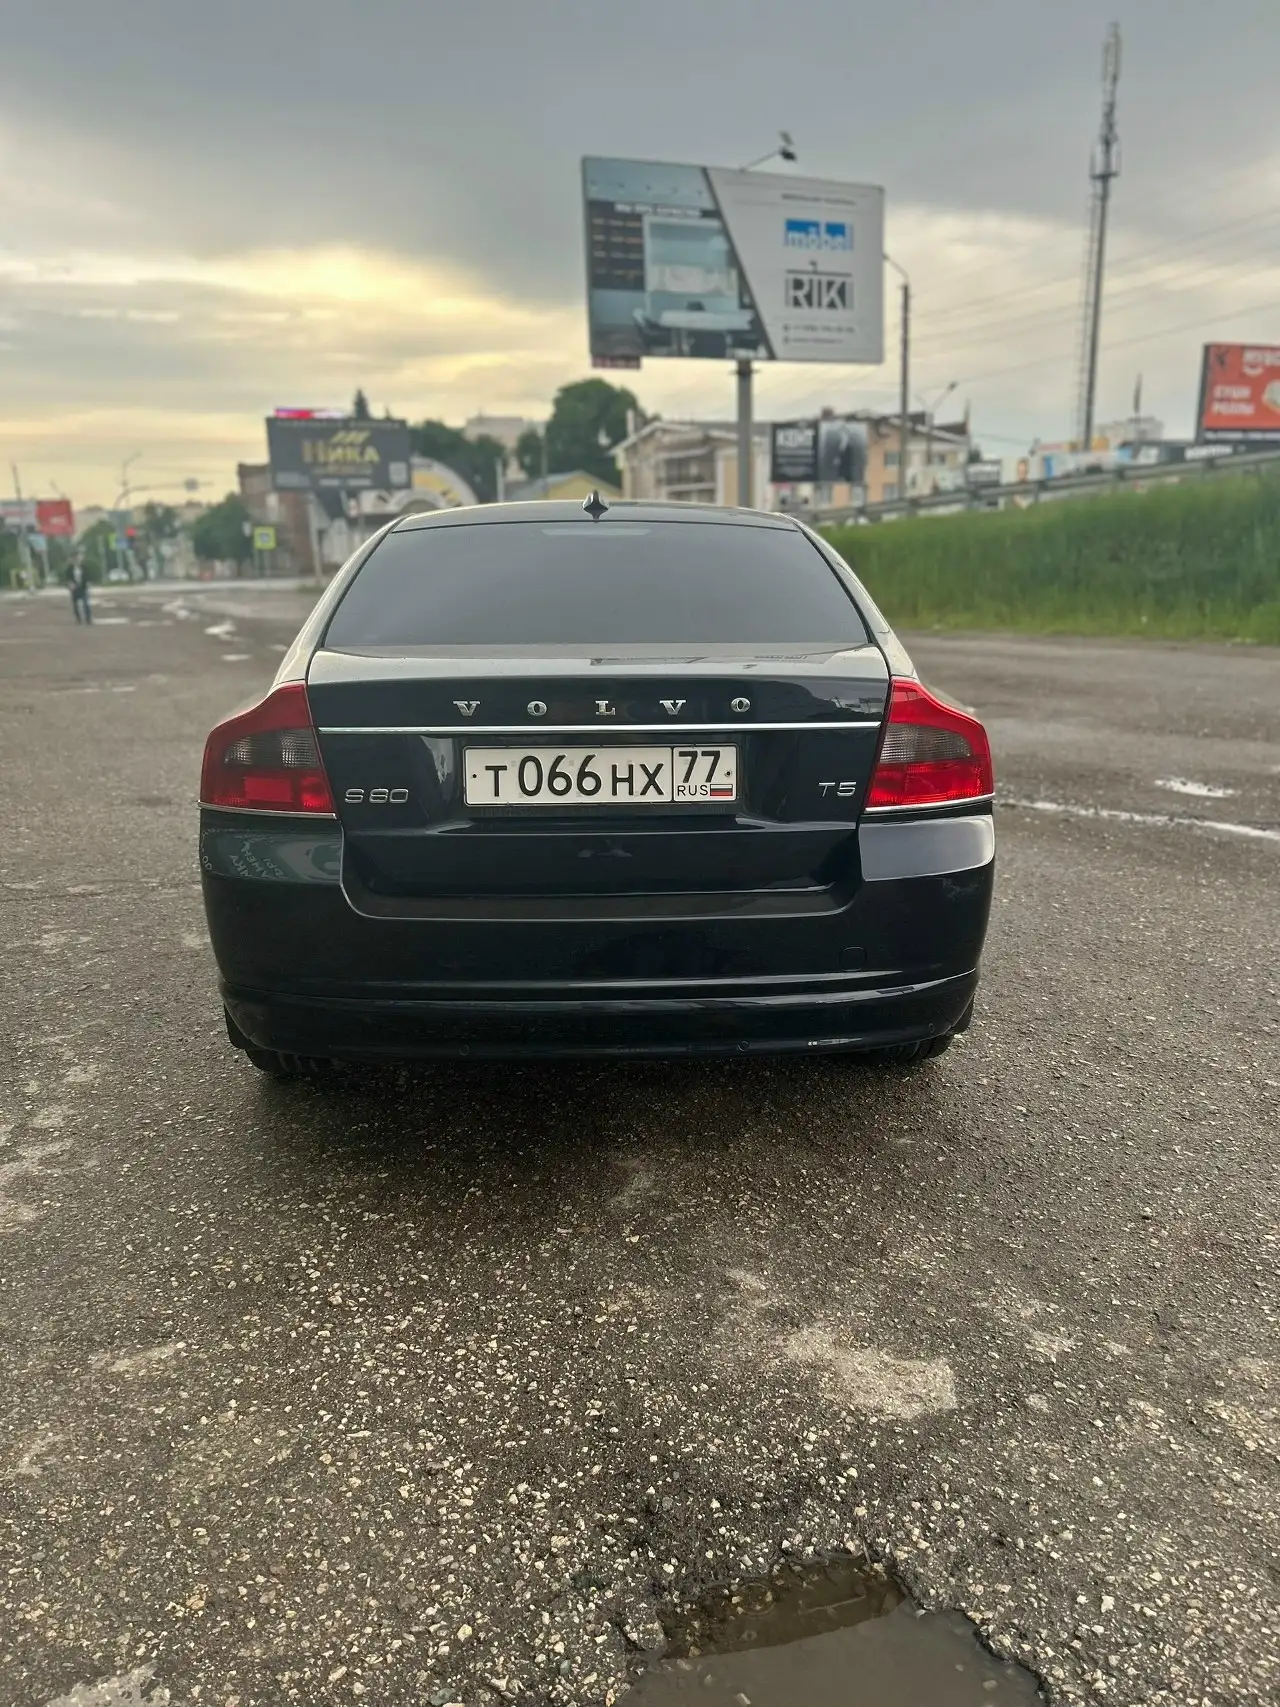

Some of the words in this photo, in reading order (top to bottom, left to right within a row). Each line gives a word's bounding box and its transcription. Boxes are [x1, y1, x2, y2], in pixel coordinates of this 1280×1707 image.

[453, 697, 750, 717] VOLVO
[678, 750, 721, 784] 77
[344, 788, 409, 804] S80
[676, 784, 709, 796] RUS
[818, 781, 857, 797] T5
